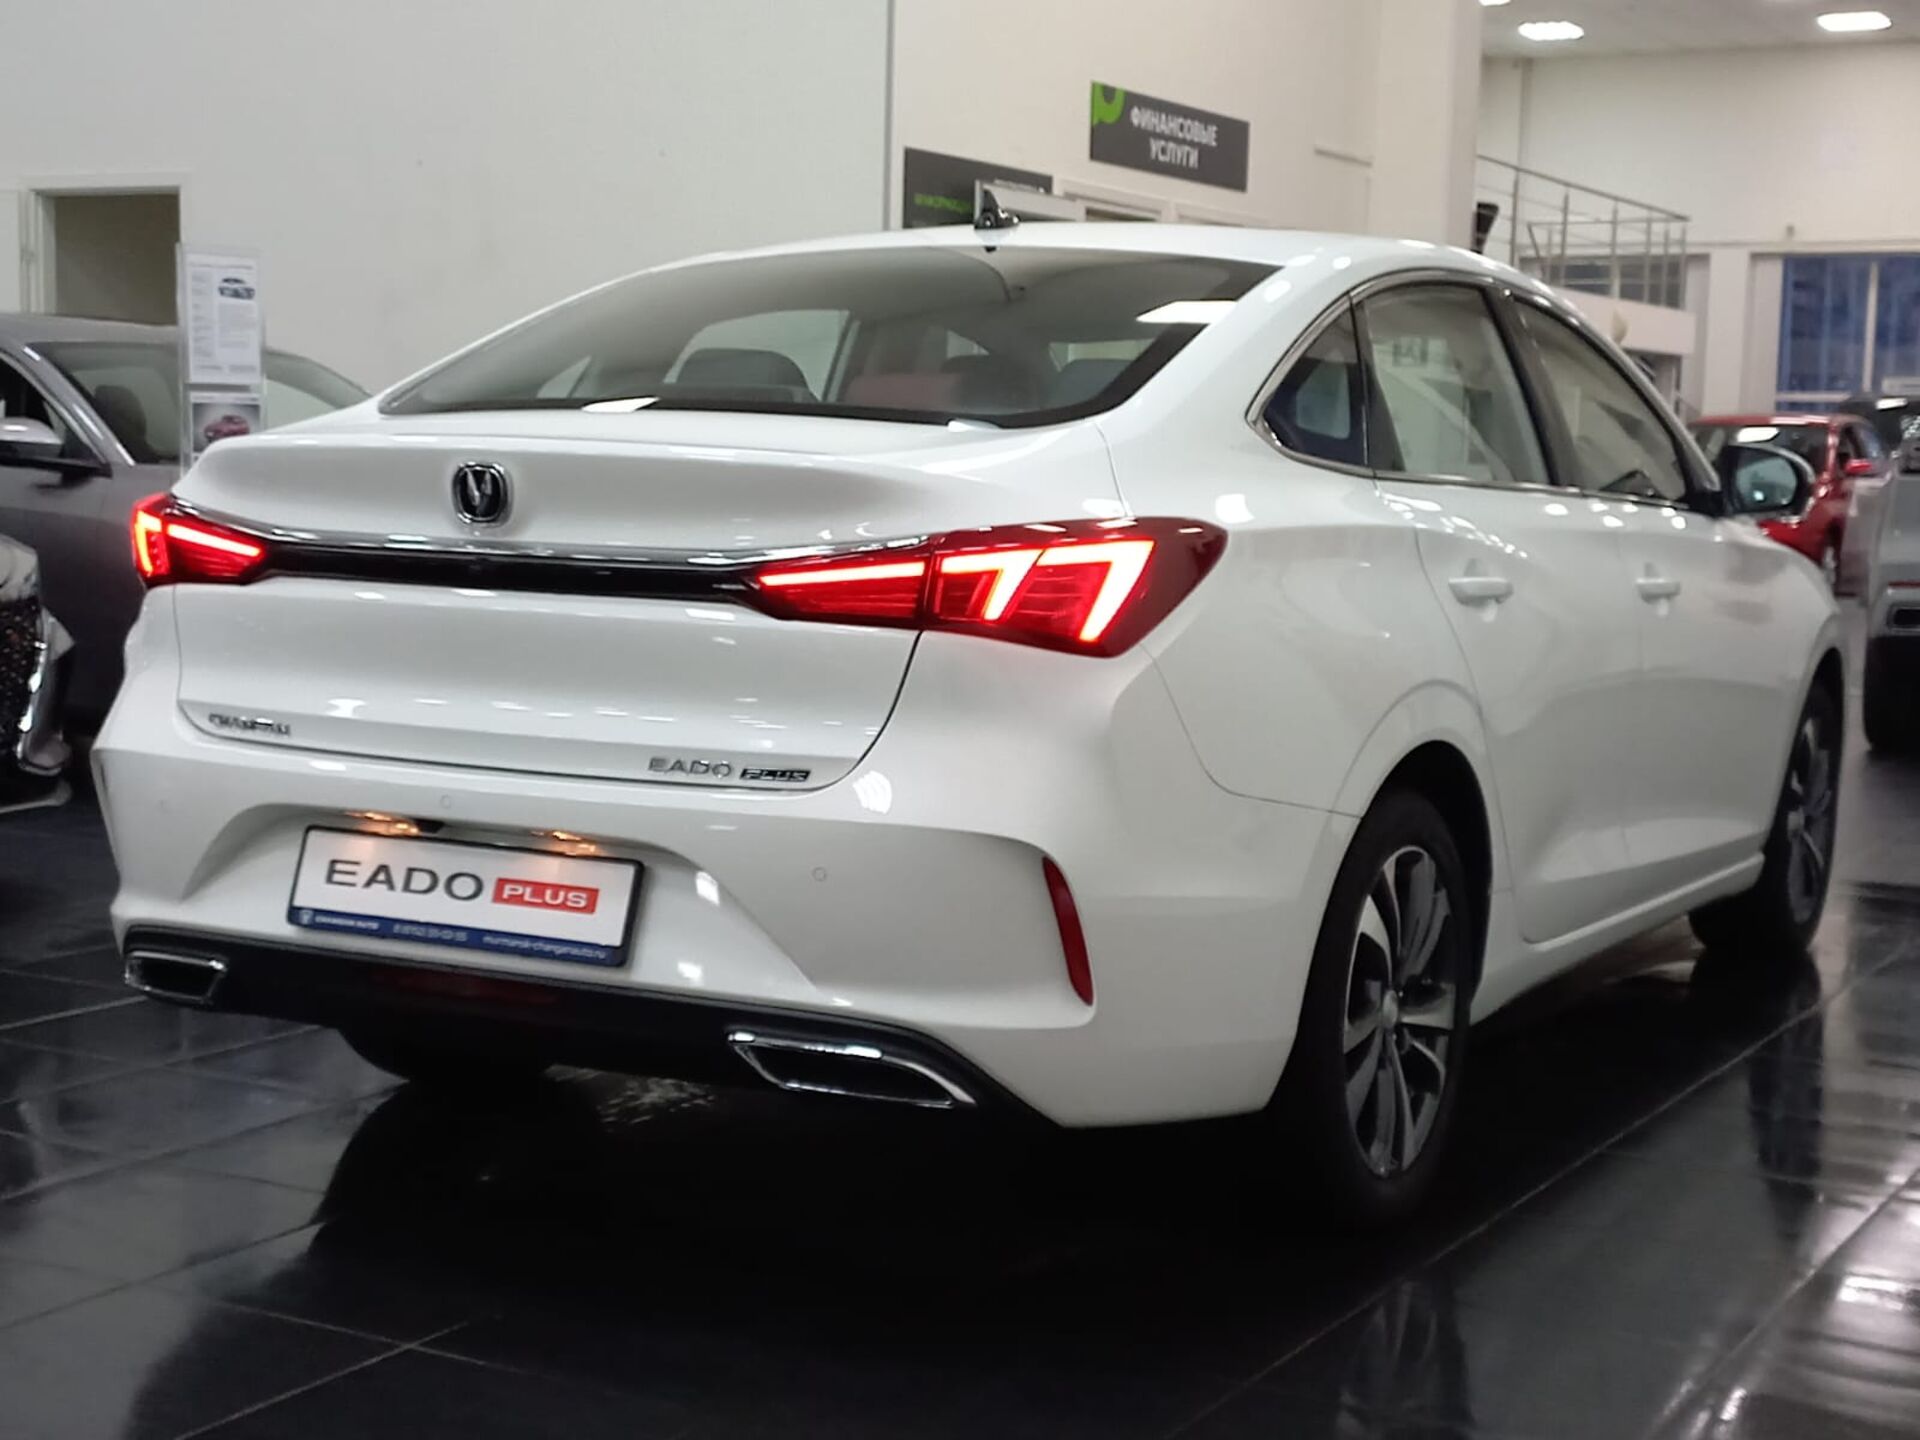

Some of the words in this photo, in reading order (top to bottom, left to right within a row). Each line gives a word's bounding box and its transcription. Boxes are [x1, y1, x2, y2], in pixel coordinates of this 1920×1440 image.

[1130, 105, 1218, 147] ФИНАНСОВЫЕ
[1149, 137, 1199, 169] УСЛУГИ
[208, 713, 291, 736] CHANN
[648, 757, 732, 778] EADO
[742, 768, 809, 782] PLUS
[325, 859, 484, 901] EADO
[502, 884, 588, 909] PLUS
